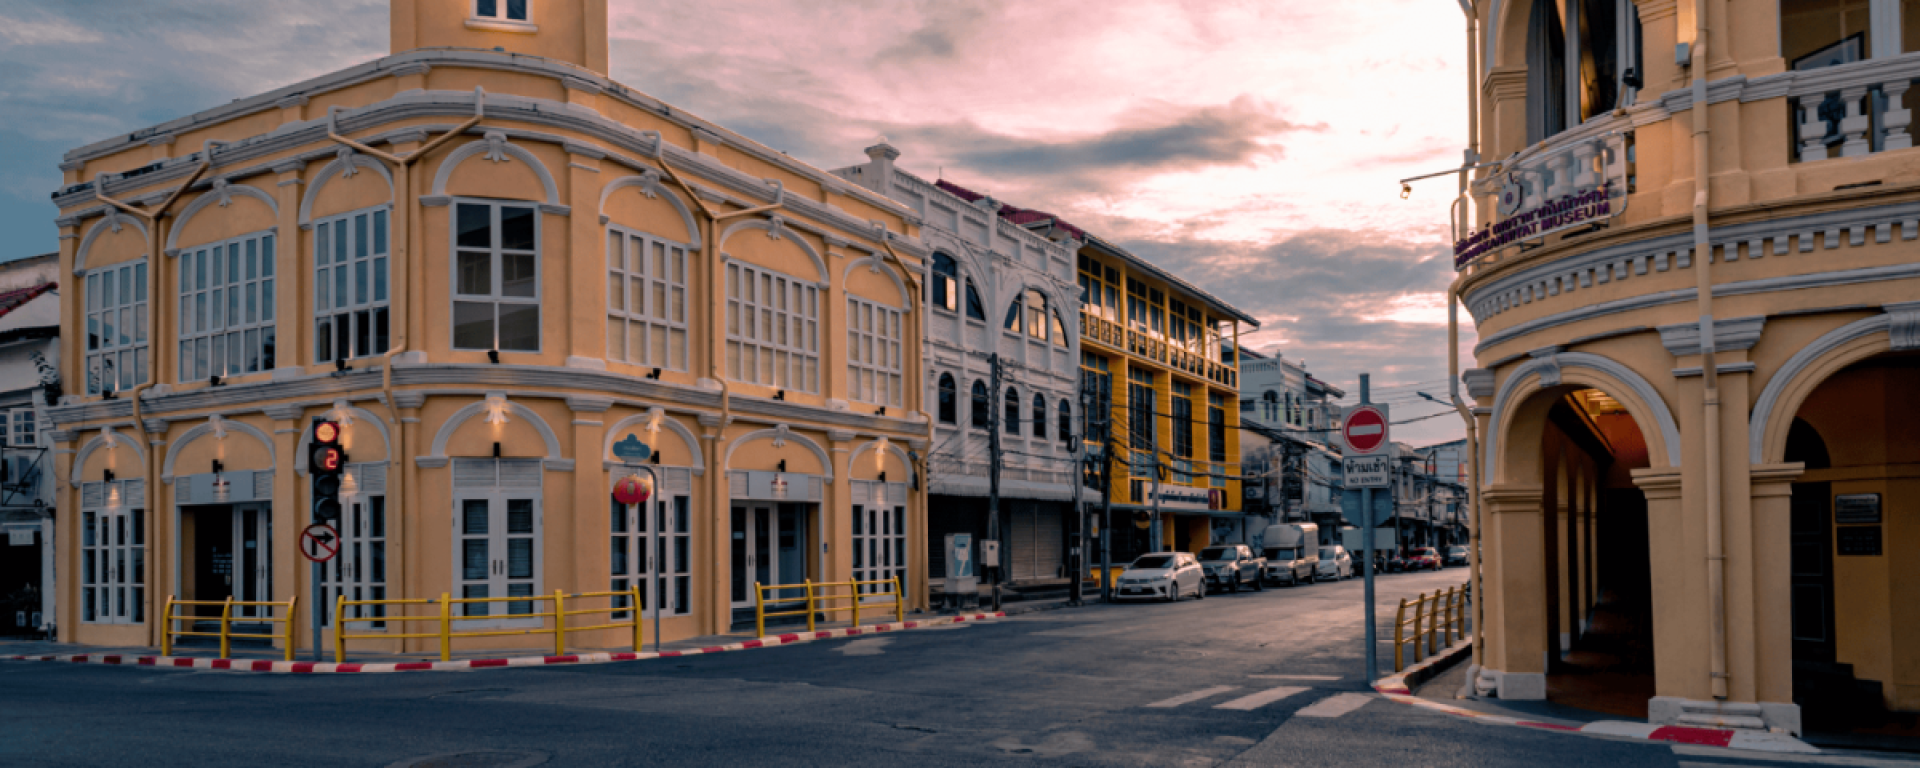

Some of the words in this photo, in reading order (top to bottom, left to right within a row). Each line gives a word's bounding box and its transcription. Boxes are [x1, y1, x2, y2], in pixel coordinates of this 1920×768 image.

[1541, 202, 1610, 231] MUSEUM
[325, 449, 337, 469] 2
[1346, 457, 1387, 474] ห้ามเข้า
